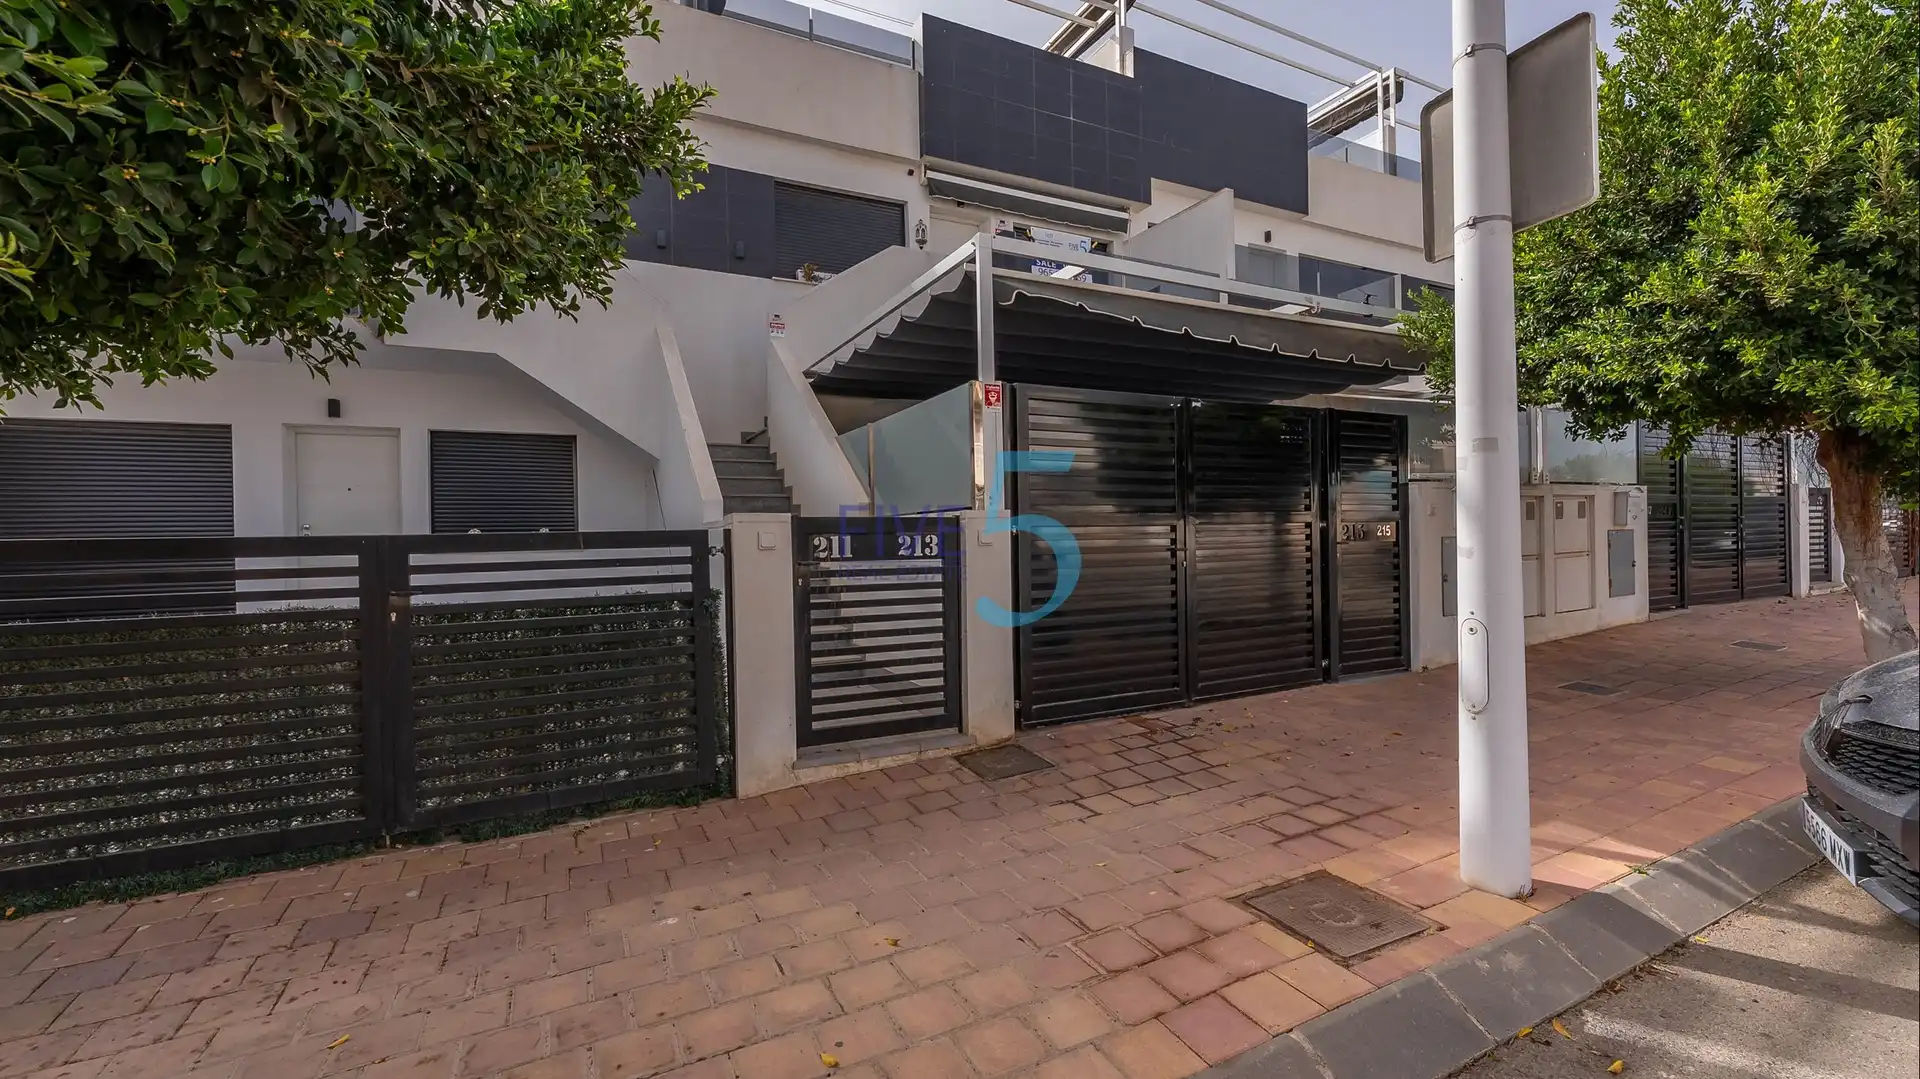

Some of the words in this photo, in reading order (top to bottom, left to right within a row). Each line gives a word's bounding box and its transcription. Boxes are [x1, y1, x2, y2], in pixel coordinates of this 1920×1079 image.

[1035, 260, 1057, 269] SALE
[1376, 524, 1392, 536] 215
[813, 535, 853, 558] 211
[898, 534, 939, 556] 213
